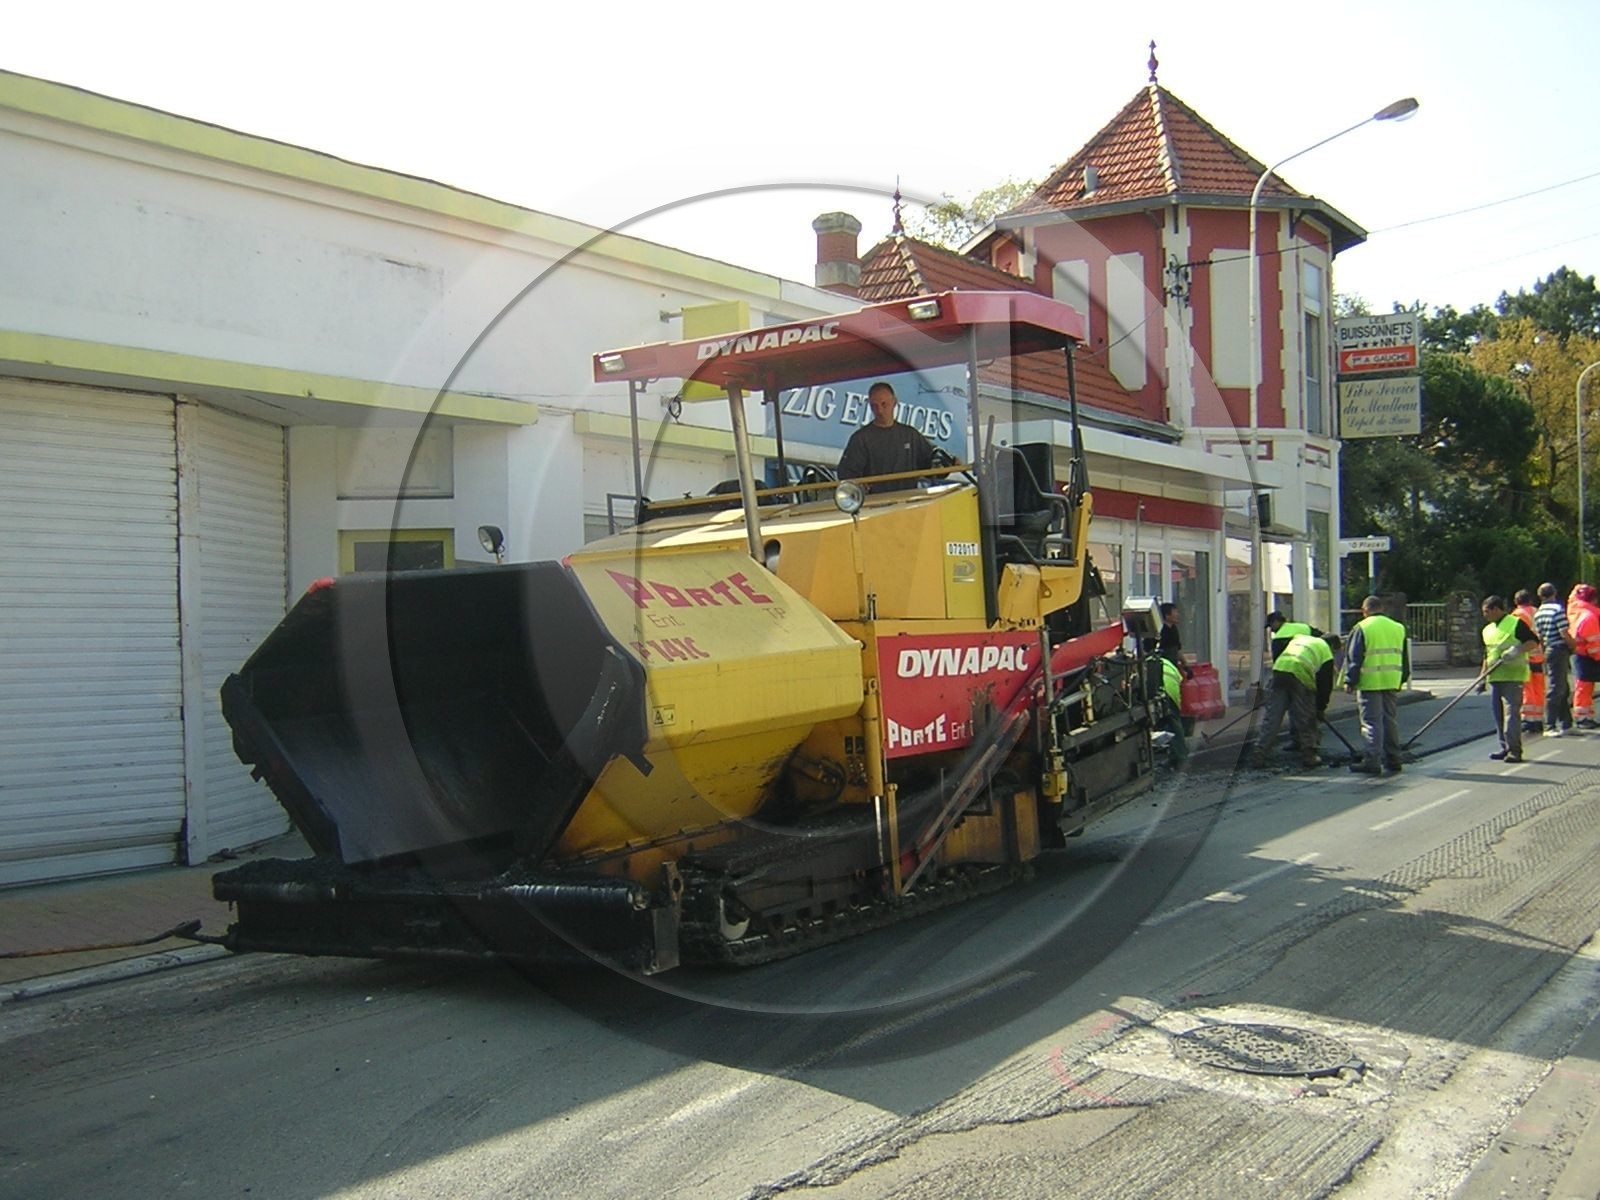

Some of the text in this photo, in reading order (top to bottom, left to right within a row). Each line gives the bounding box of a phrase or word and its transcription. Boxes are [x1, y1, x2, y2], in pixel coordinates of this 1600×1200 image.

[1341, 322, 1413, 340] BUISSONNETS
[1369, 316, 1386, 324] LES
[697, 321, 840, 360] DYNAPAC
[783, 386, 837, 420] ZIG
[895, 402, 953, 440] UCES
[604, 572, 774, 609] PORTE
[897, 645, 1030, 678] DYNAPAC
[887, 713, 946, 749] PORTE
